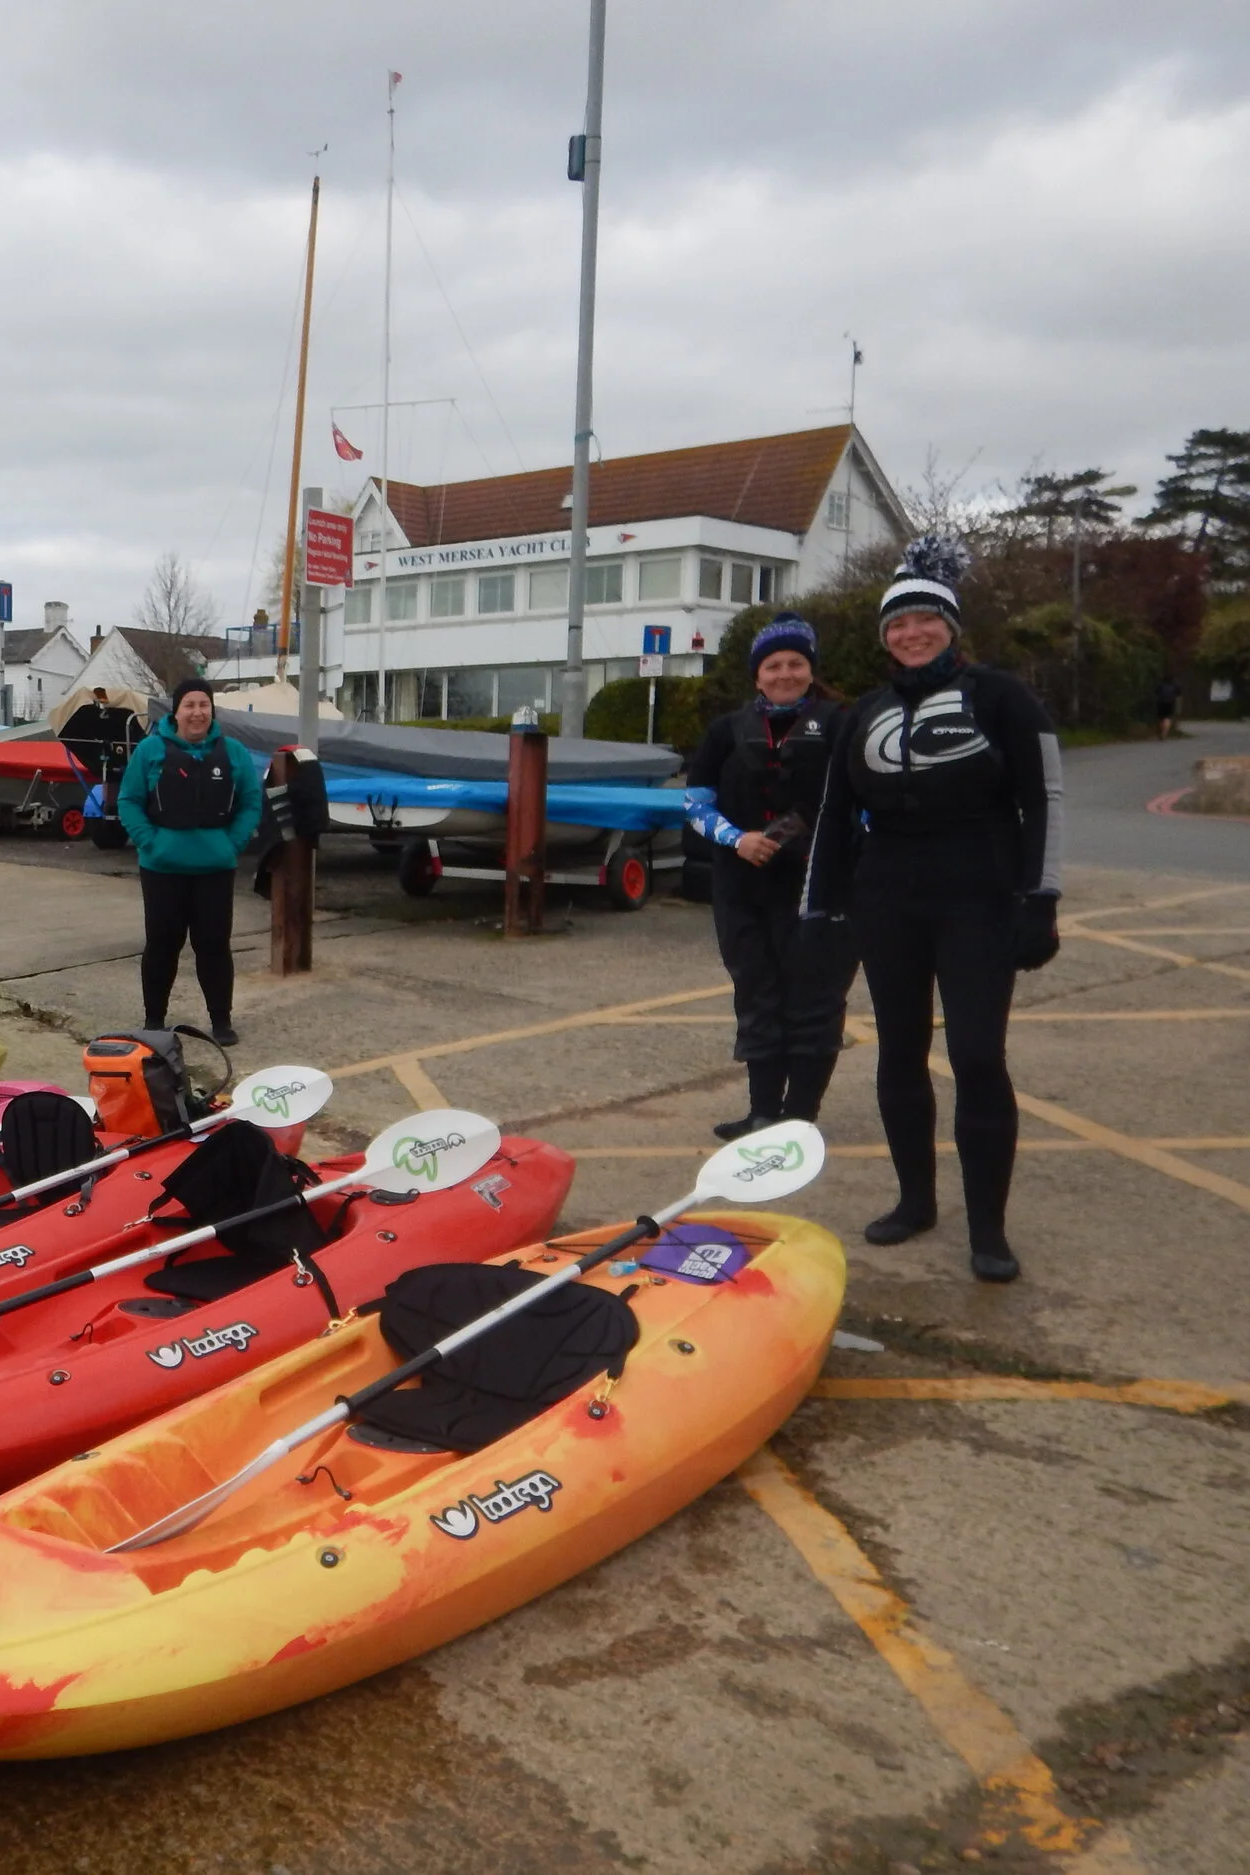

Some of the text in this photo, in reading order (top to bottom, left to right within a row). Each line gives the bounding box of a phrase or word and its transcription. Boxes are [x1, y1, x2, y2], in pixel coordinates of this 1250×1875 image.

[318, 532, 342, 550] Parking
[398, 553, 435, 568] WEST
[438, 547, 495, 565] MERSEA
[499, 541, 547, 558] YACHT
